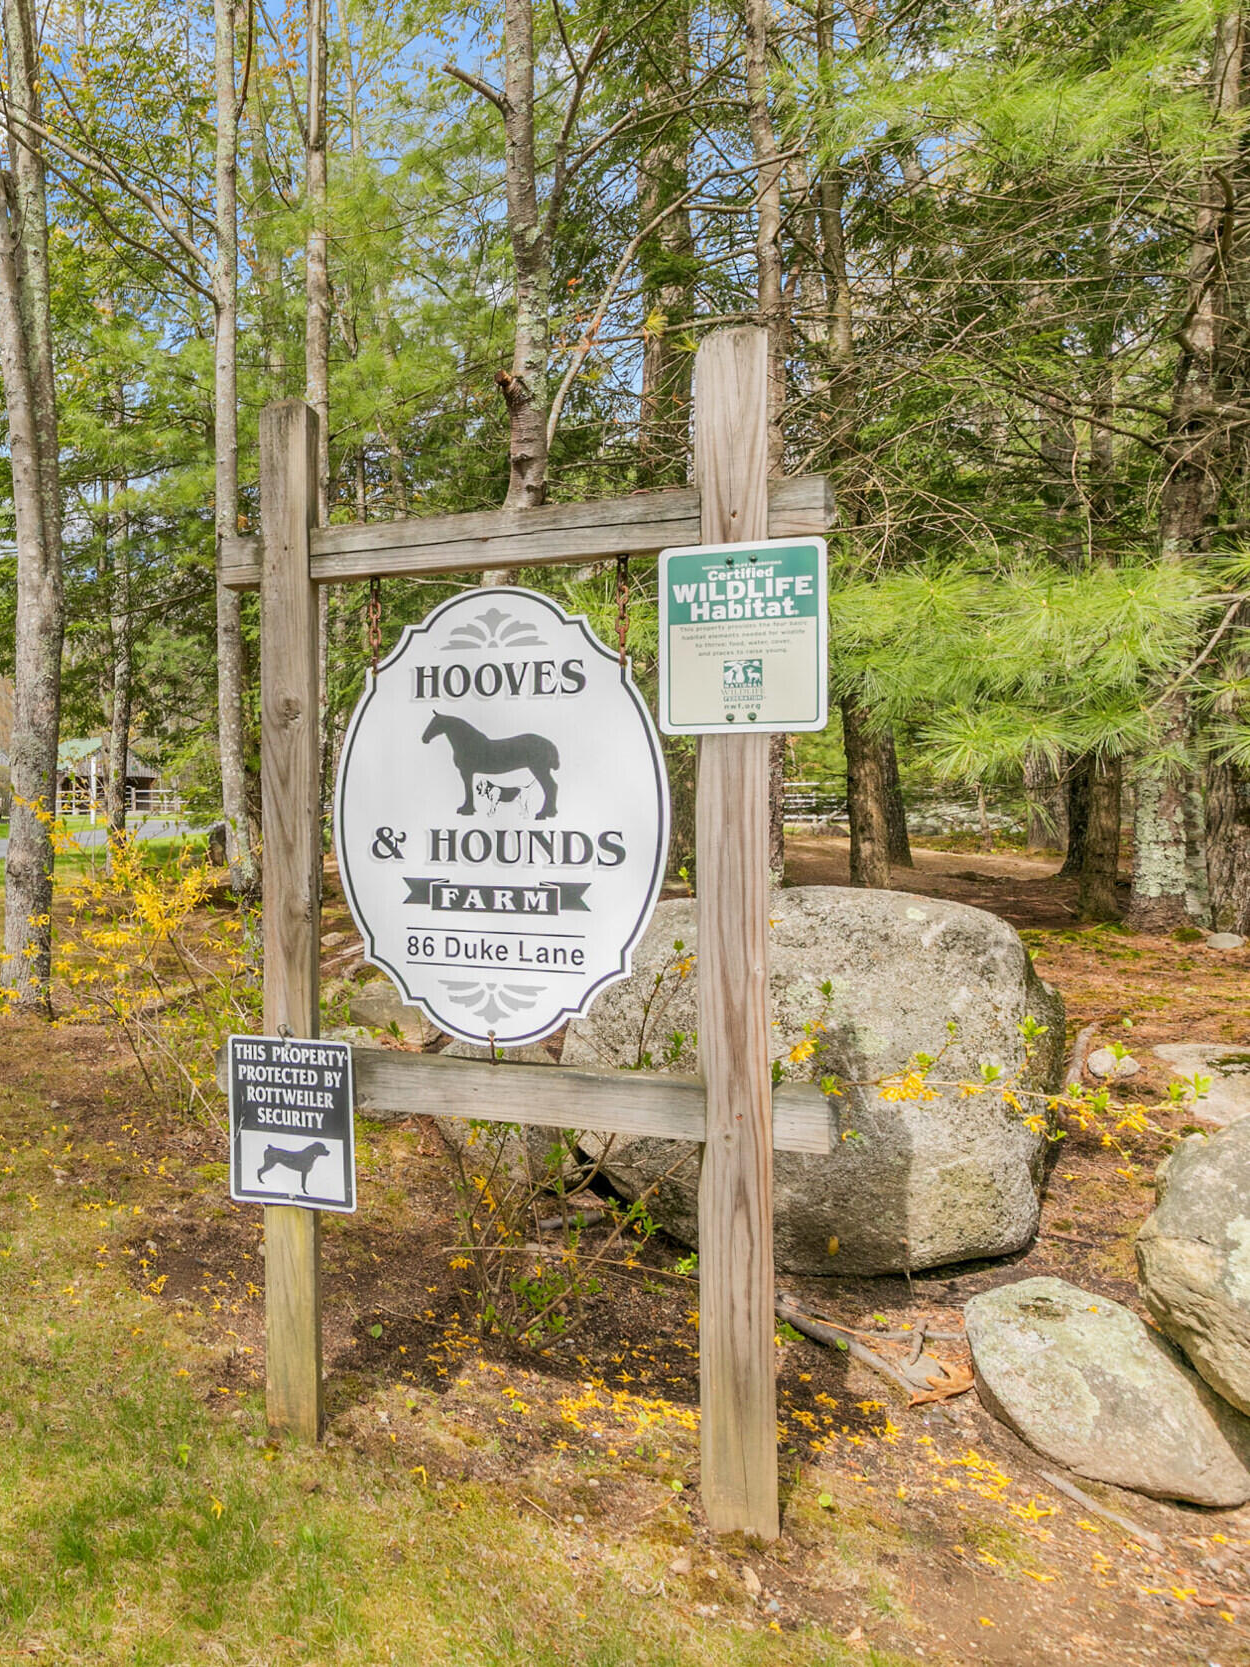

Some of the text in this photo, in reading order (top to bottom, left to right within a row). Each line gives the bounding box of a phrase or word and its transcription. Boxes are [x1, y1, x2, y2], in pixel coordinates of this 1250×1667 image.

[707, 566, 774, 581] Certified
[672, 575, 814, 603] WILDLIFE
[414, 659, 587, 699] HOOVES
[371, 827, 627, 867] & HOUNDS
[440, 888, 550, 913] FARM
[407, 935, 586, 966] 86 Duke Lane
[234, 1043, 345, 1067] THIS PROPERTY
[238, 1064, 342, 1088] PROTECTED BY
[246, 1085, 334, 1109] ROTTWEILER
[257, 1107, 324, 1129] SECURITY
